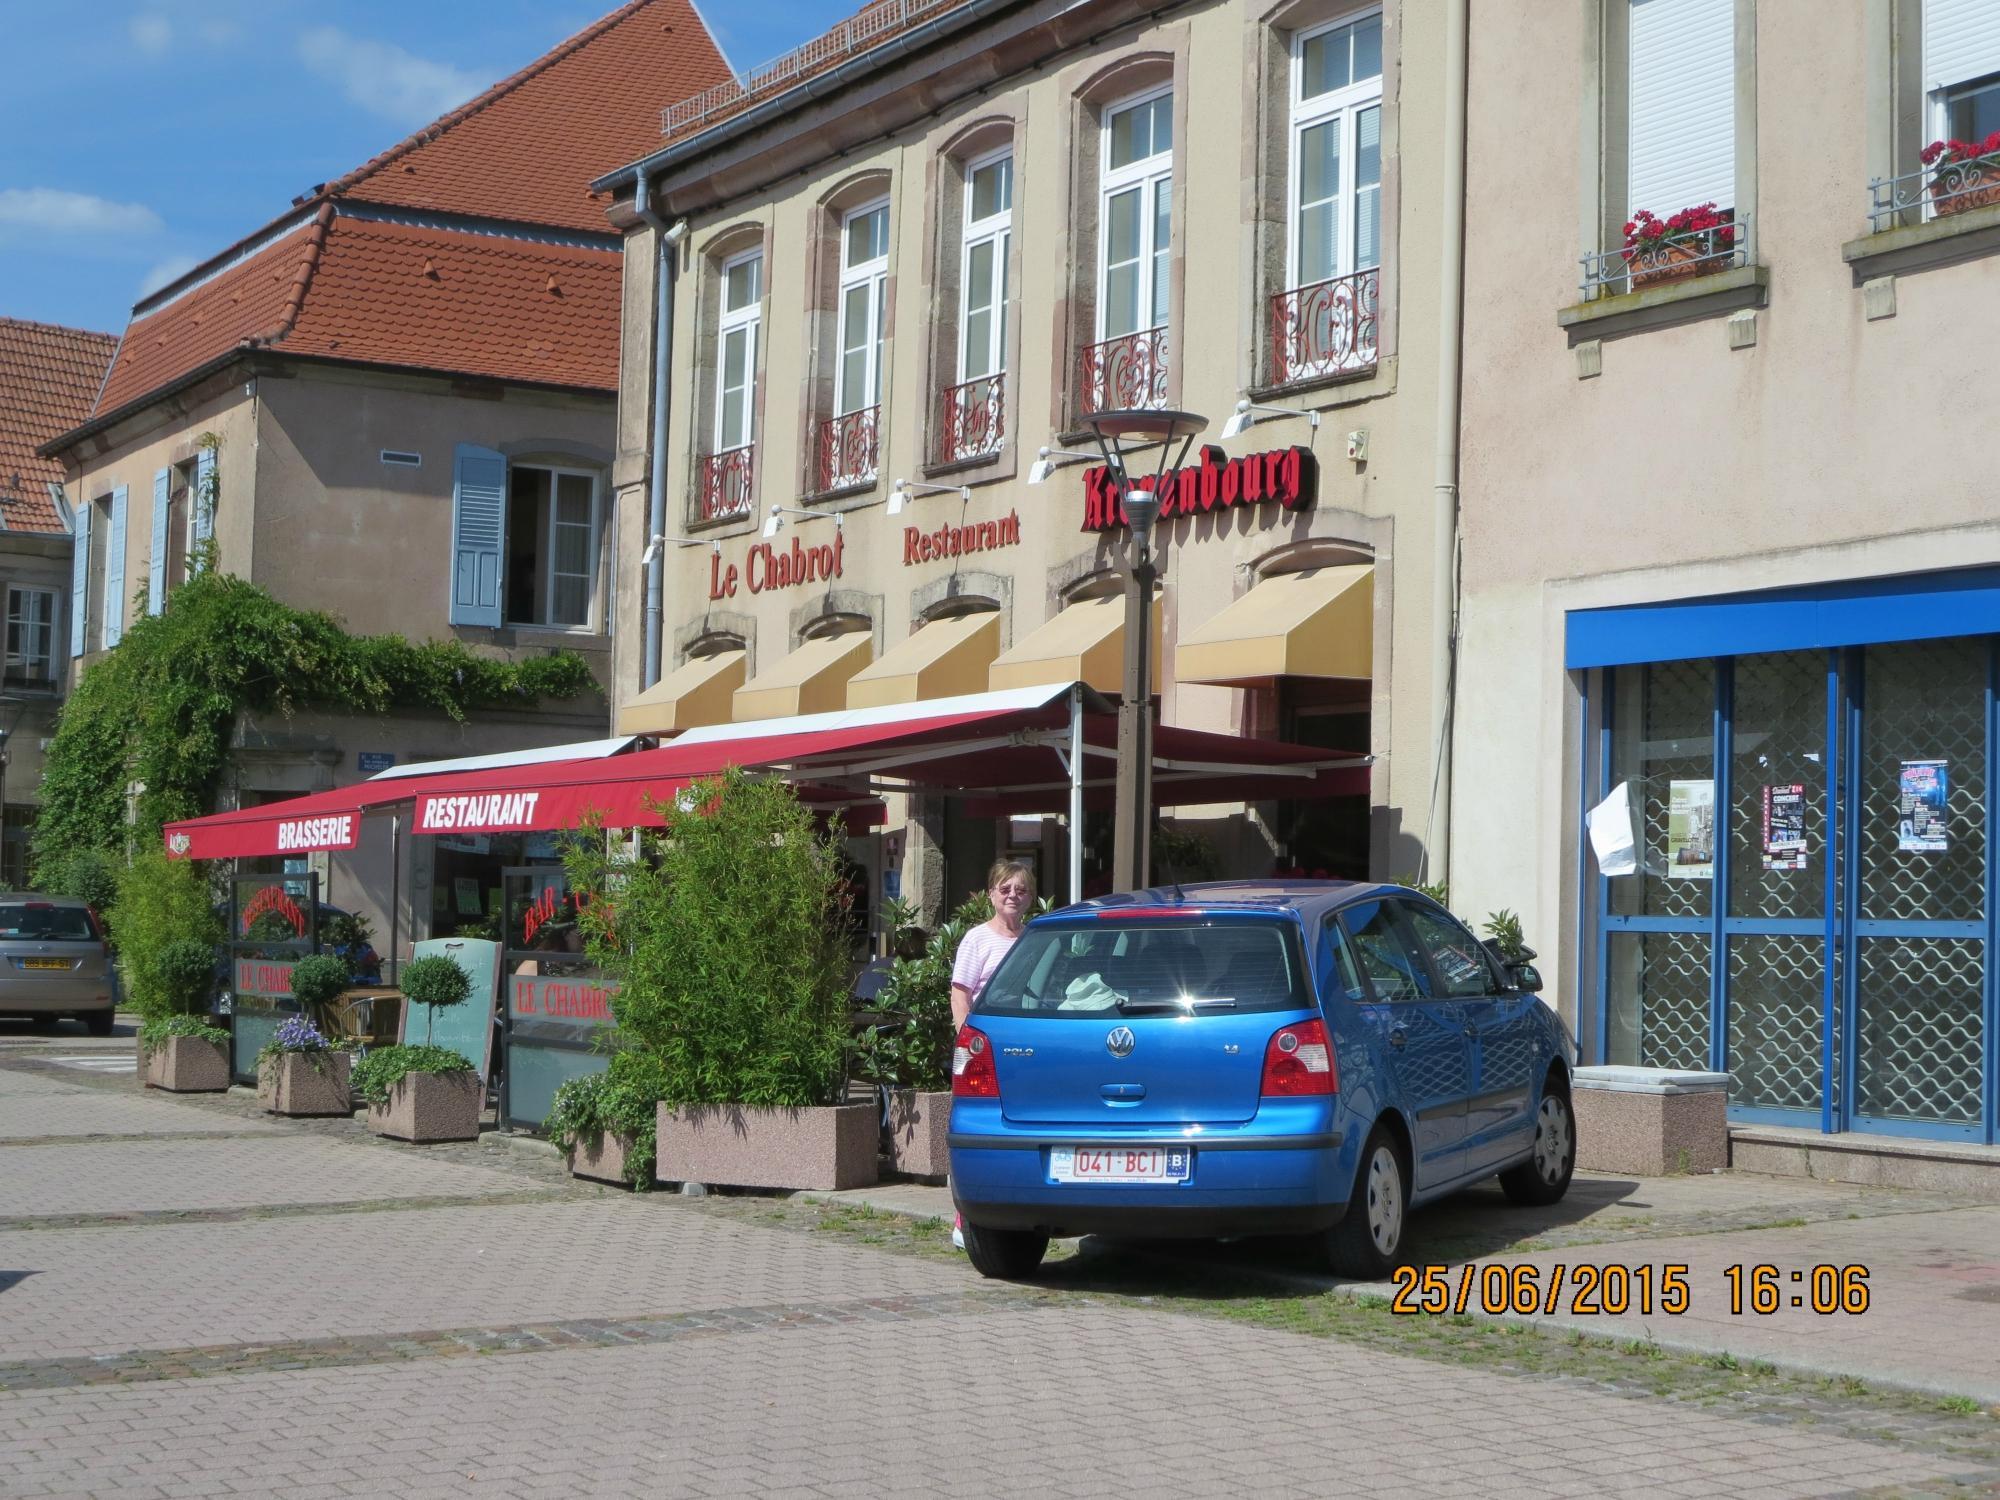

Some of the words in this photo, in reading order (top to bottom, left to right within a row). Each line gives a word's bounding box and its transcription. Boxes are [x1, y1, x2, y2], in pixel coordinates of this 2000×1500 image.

[903, 508, 1021, 566] Restaurant
[709, 553, 738, 600] Le
[746, 529, 844, 594] Chabrot
[423, 793, 539, 828] RESTAURANT
[278, 816, 351, 850] BRASSERIE
[523, 886, 557, 944] BAR
[516, 982, 536, 1013] LE
[1172, 1154, 1182, 1167] B
